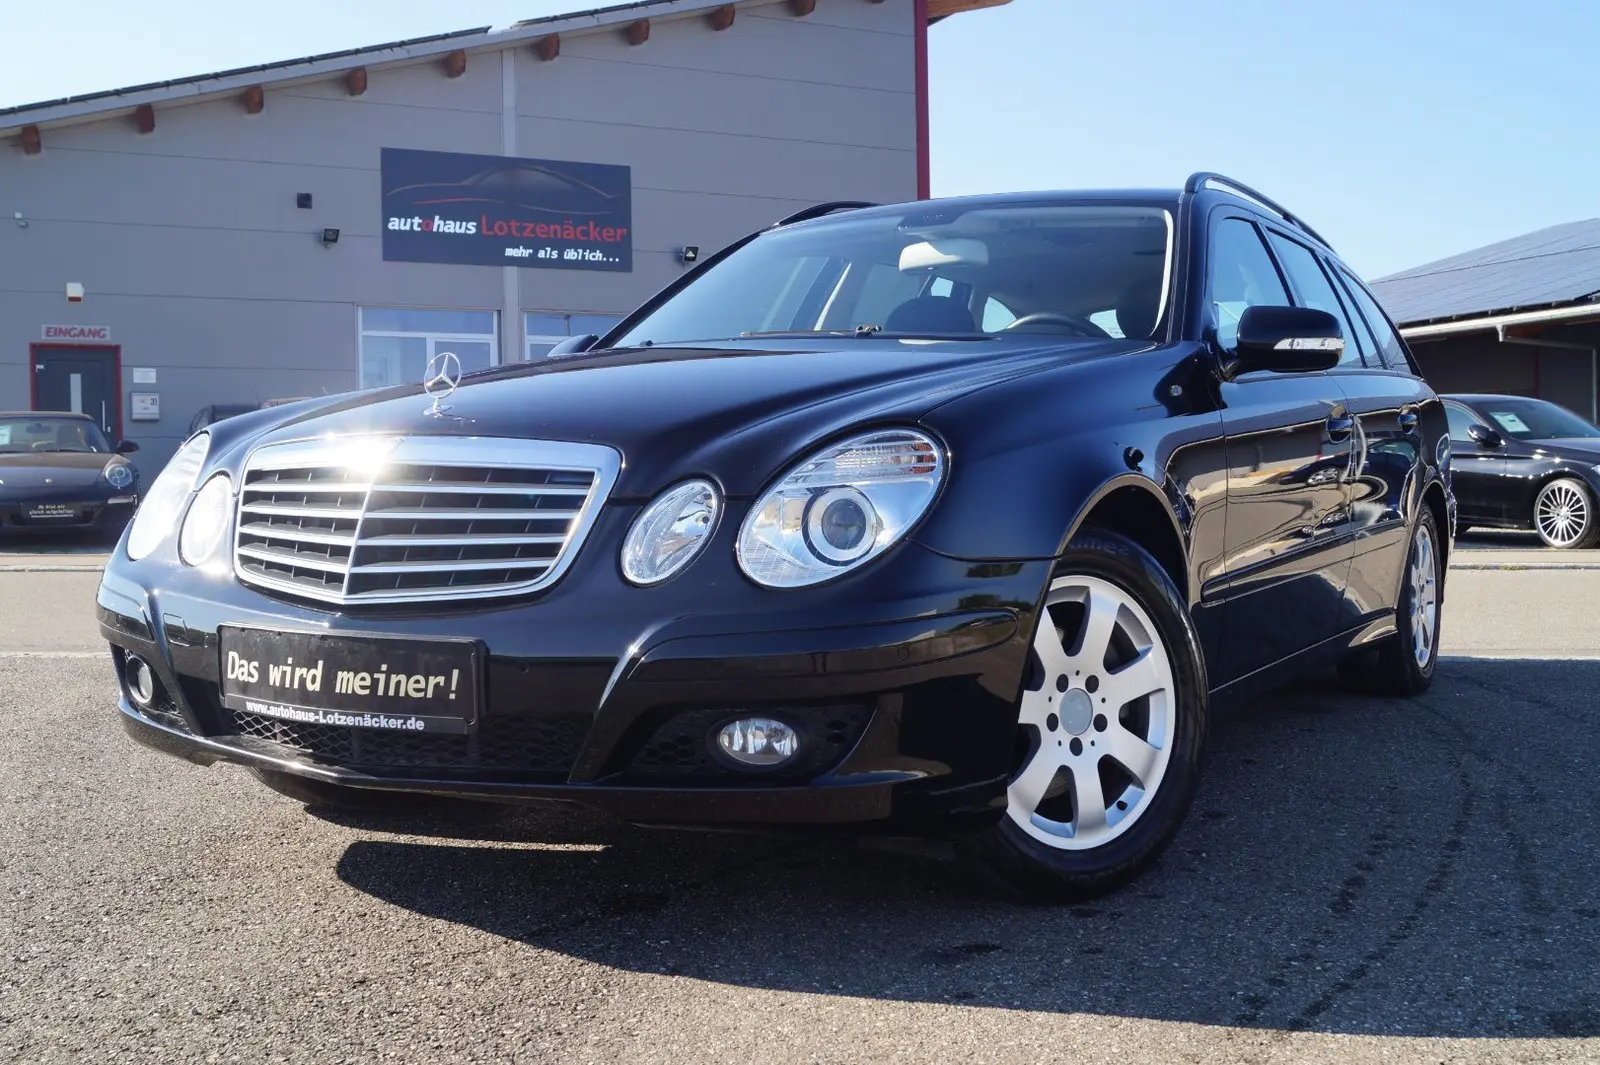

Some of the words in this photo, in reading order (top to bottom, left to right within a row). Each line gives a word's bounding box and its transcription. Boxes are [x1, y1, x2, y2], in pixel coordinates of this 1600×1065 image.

[388, 215, 477, 235] autohaus
[481, 214, 628, 242] Lotzenäcker
[505, 245, 533, 258] mehr
[537, 248, 558, 259] als
[563, 249, 620, 262] üblich...
[45, 326, 107, 339] EINGANG
[227, 651, 260, 683] Das
[269, 657, 324, 692] wird
[335, 664, 460, 700] meiner!
[245, 701, 425, 731] www.autohaus-Lotzenäcker.de
